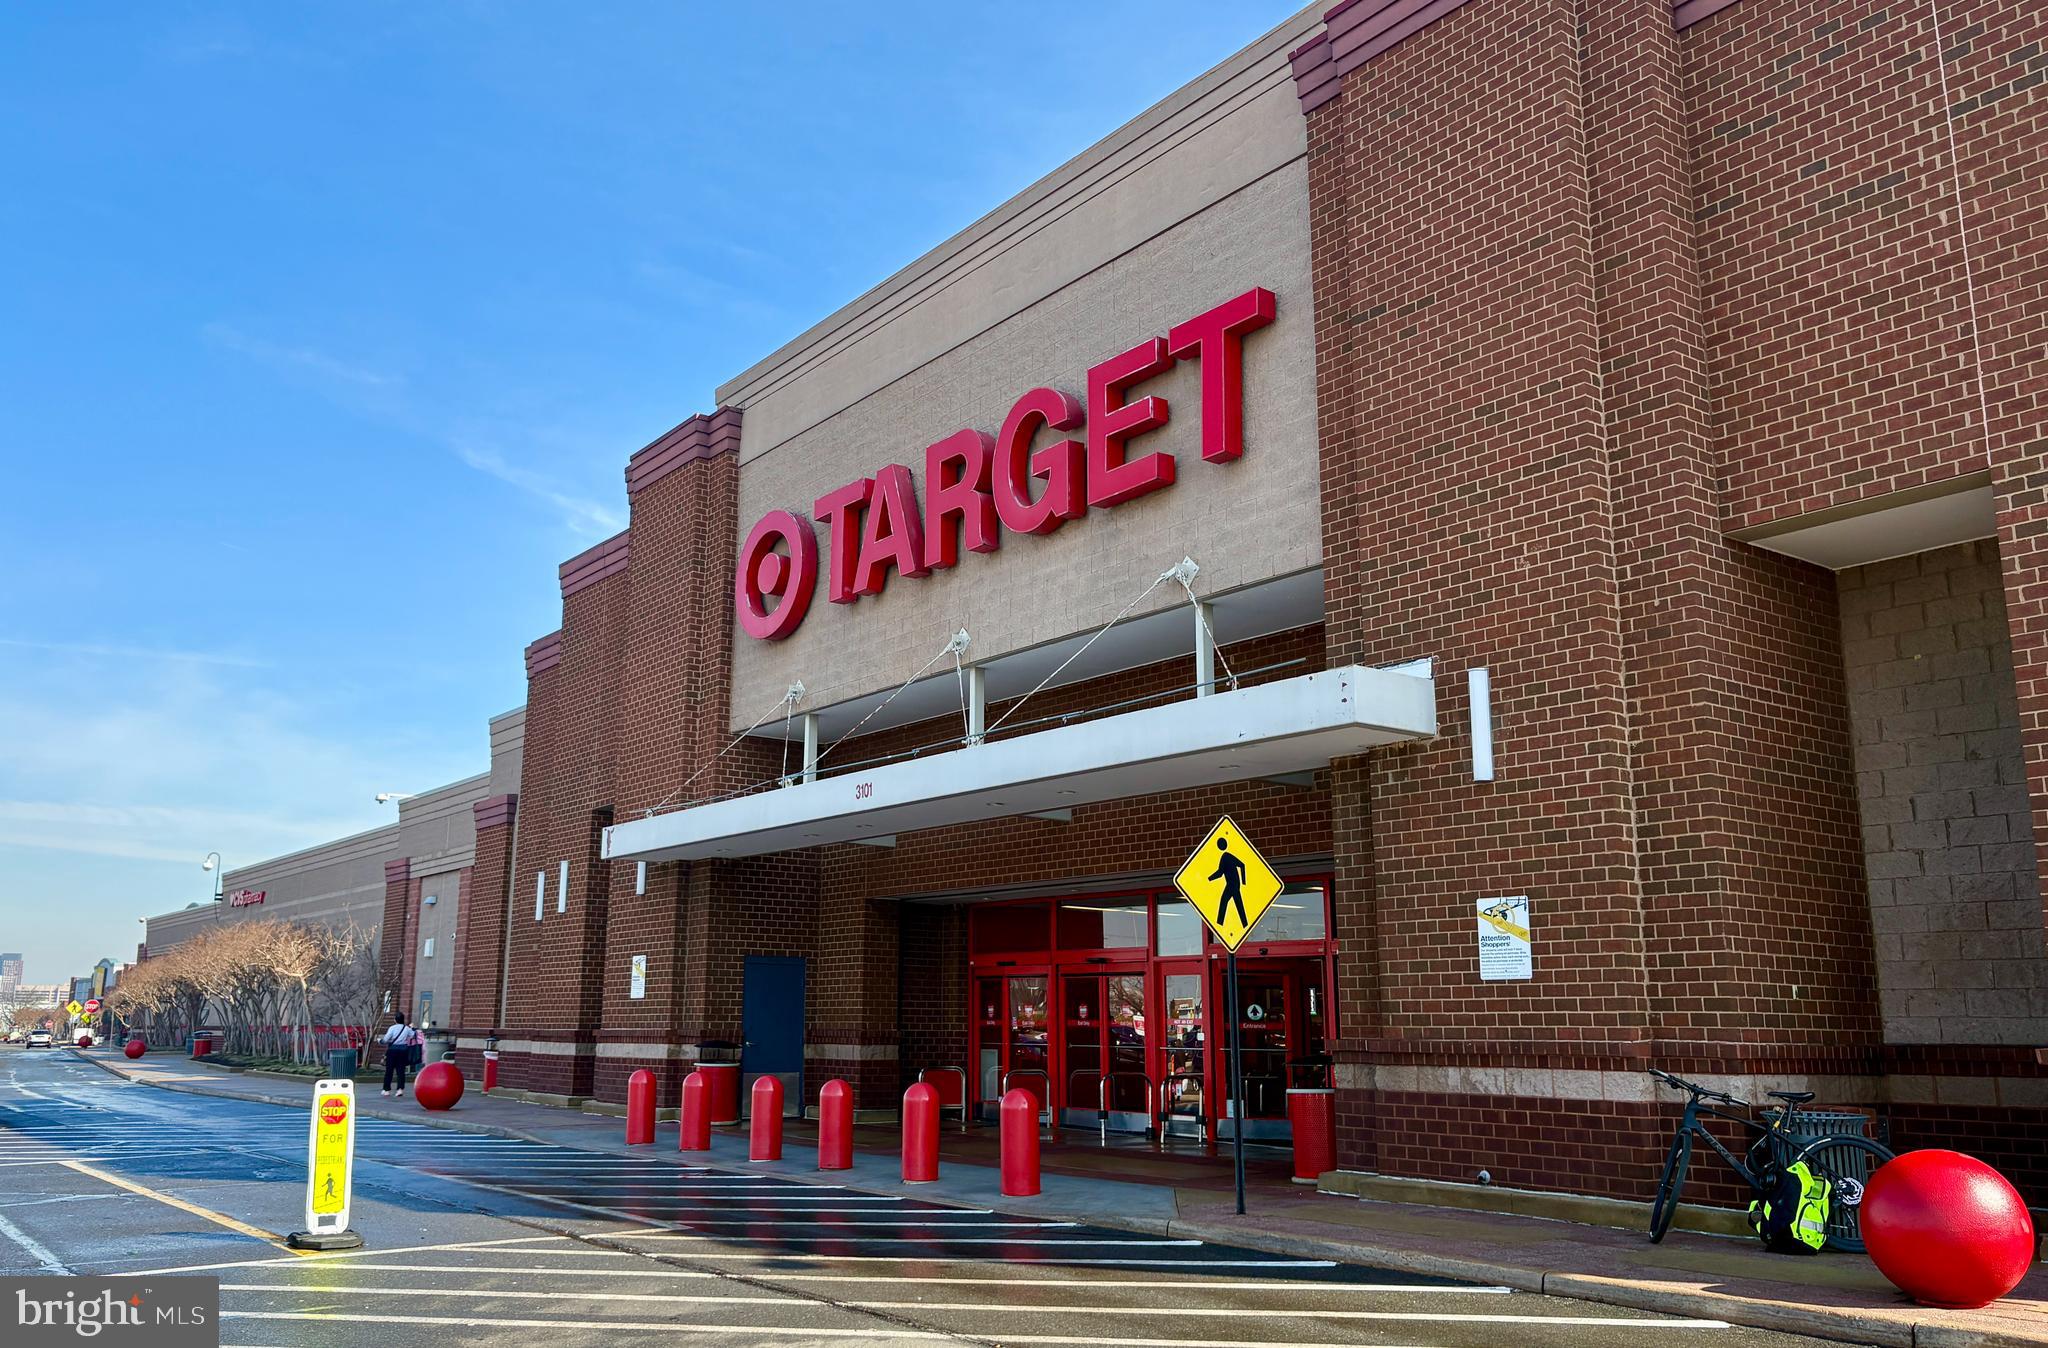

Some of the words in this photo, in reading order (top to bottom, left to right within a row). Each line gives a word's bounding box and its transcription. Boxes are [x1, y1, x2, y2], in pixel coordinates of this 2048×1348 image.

[815, 287, 1276, 604] TARGET
[856, 782, 873, 799] 3101
[321, 1106, 347, 1117] STOP
[322, 1134, 343, 1143] FOR
